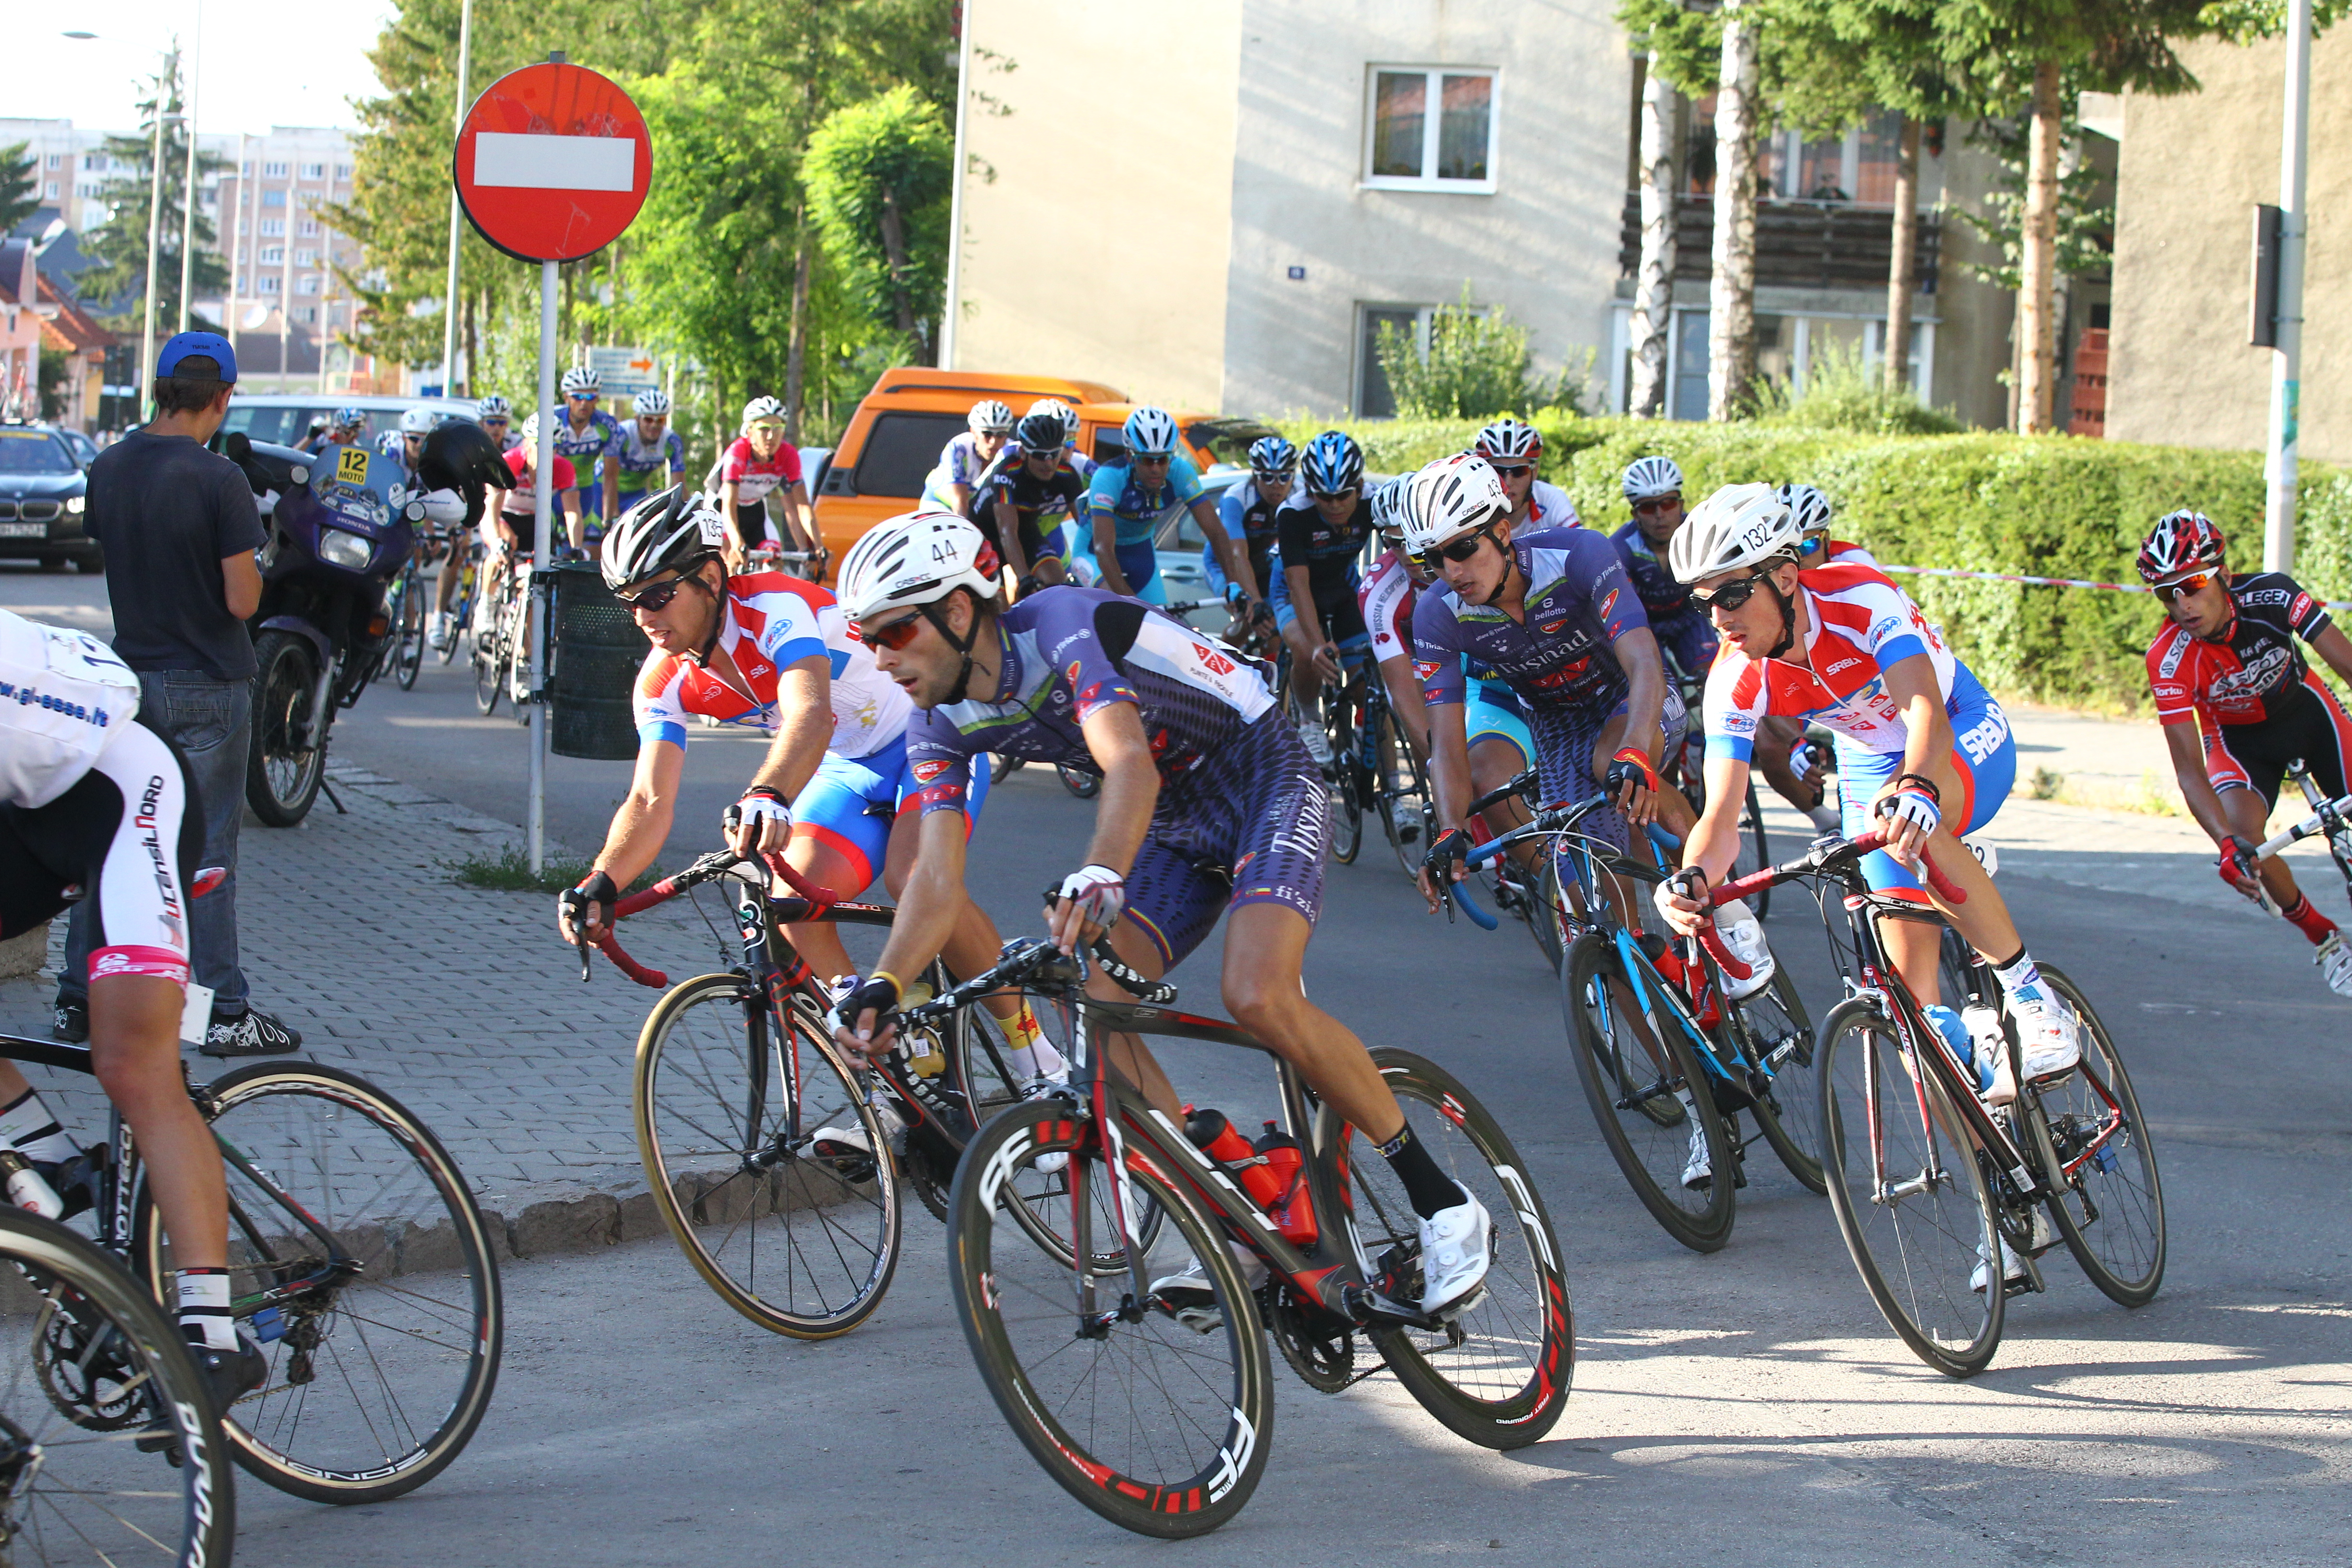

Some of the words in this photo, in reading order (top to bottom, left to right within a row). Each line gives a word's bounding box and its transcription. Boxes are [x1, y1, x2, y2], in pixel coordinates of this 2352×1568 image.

[342, 450, 367, 472] 12
[338, 470, 364, 482] MOTO
[1488, 478, 1502, 499] 43
[337, 516, 371, 533] HONDA
[1742, 523, 1773, 551] 132
[932, 539, 958, 564] 44
[1378, 572, 1407, 604] HELICOPTERS
[1373, 603, 1384, 632] RUSSIAN
[1534, 606, 1567, 621] bellotto
[2291, 594, 2310, 623] Torku
[1545, 622, 1559, 631] MOL
[1199, 648, 1229, 670] SET
[2154, 686, 2183, 697] Torku
[922, 786, 958, 801] SET
[1534, 1392, 1550, 1414] FAST
[1495, 1409, 1534, 1425] FORWARD
